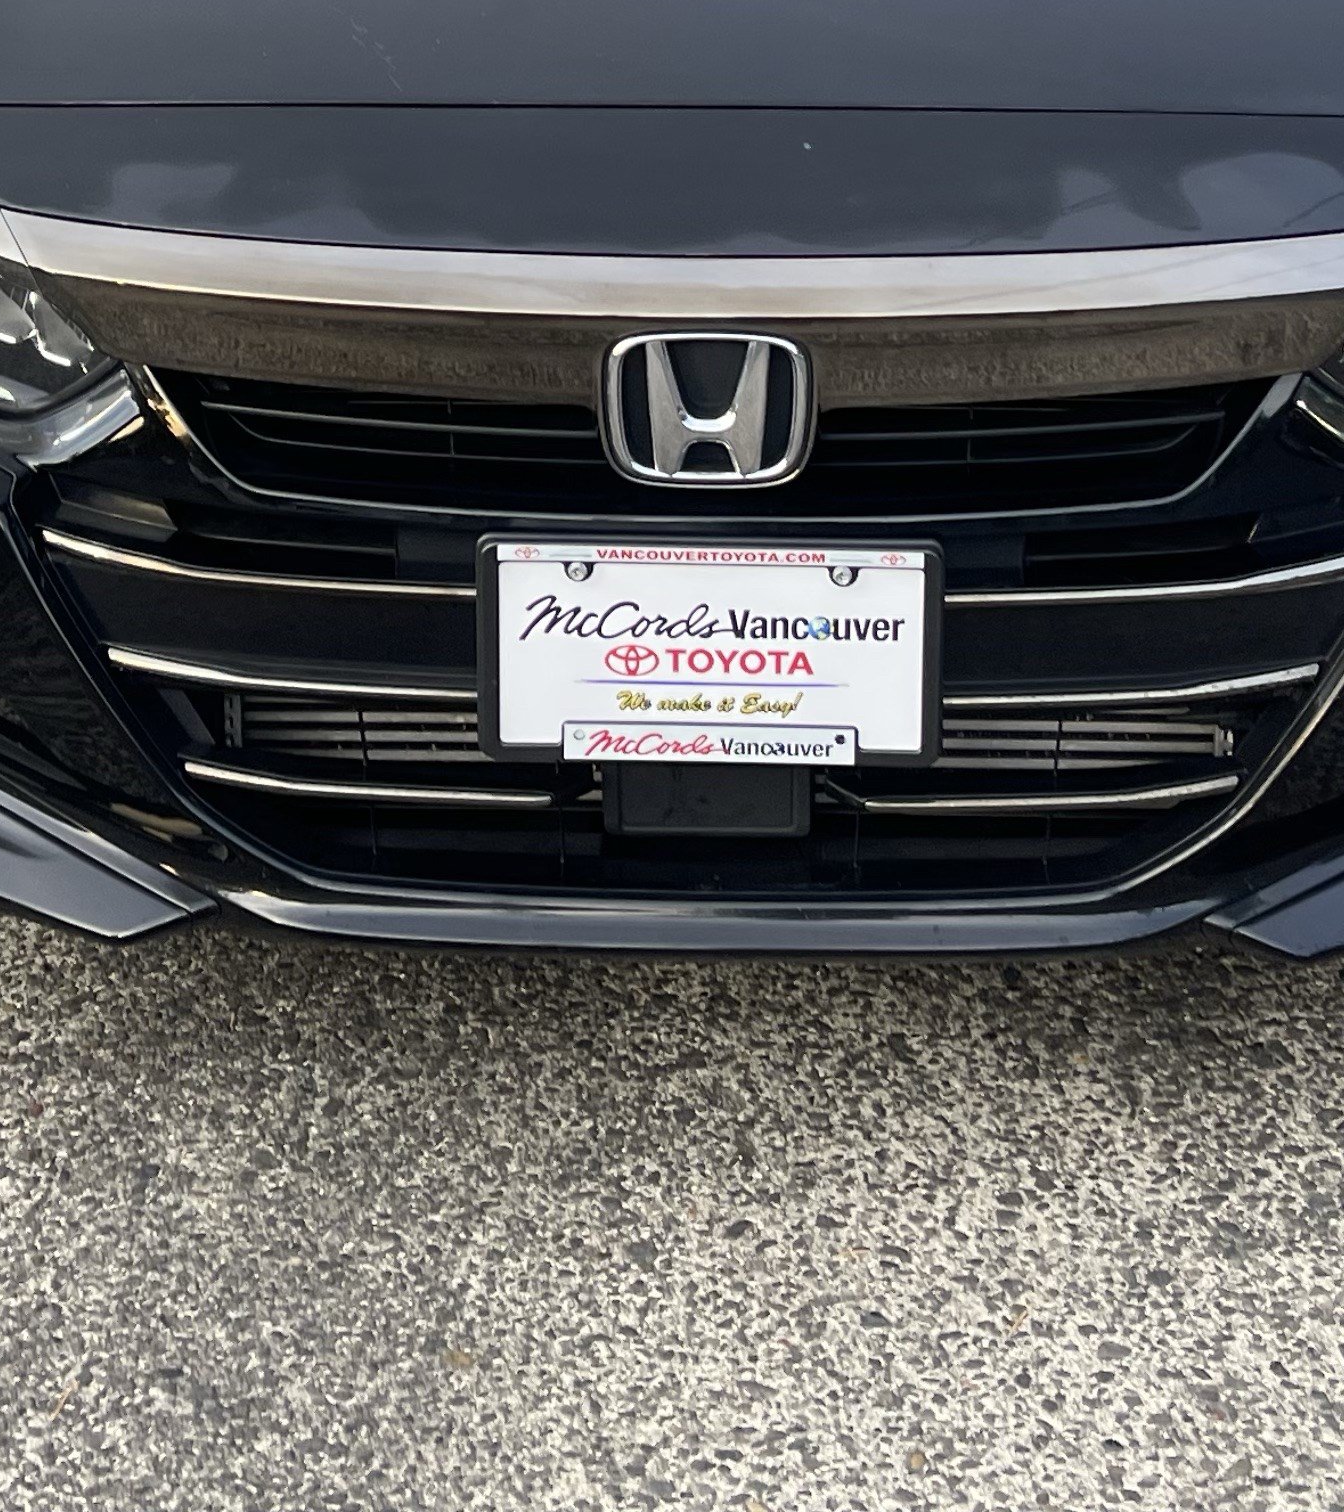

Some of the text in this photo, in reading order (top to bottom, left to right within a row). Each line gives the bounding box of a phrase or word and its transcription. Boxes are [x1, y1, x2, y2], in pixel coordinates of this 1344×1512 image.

[596, 548, 826, 564] VANCOUVERTOYOTA.COM
[519, 594, 728, 641] McCords
[665, 648, 814, 676] TOYOTA
[617, 690, 805, 719] We make it Easy!
[585, 729, 720, 757] McCords
